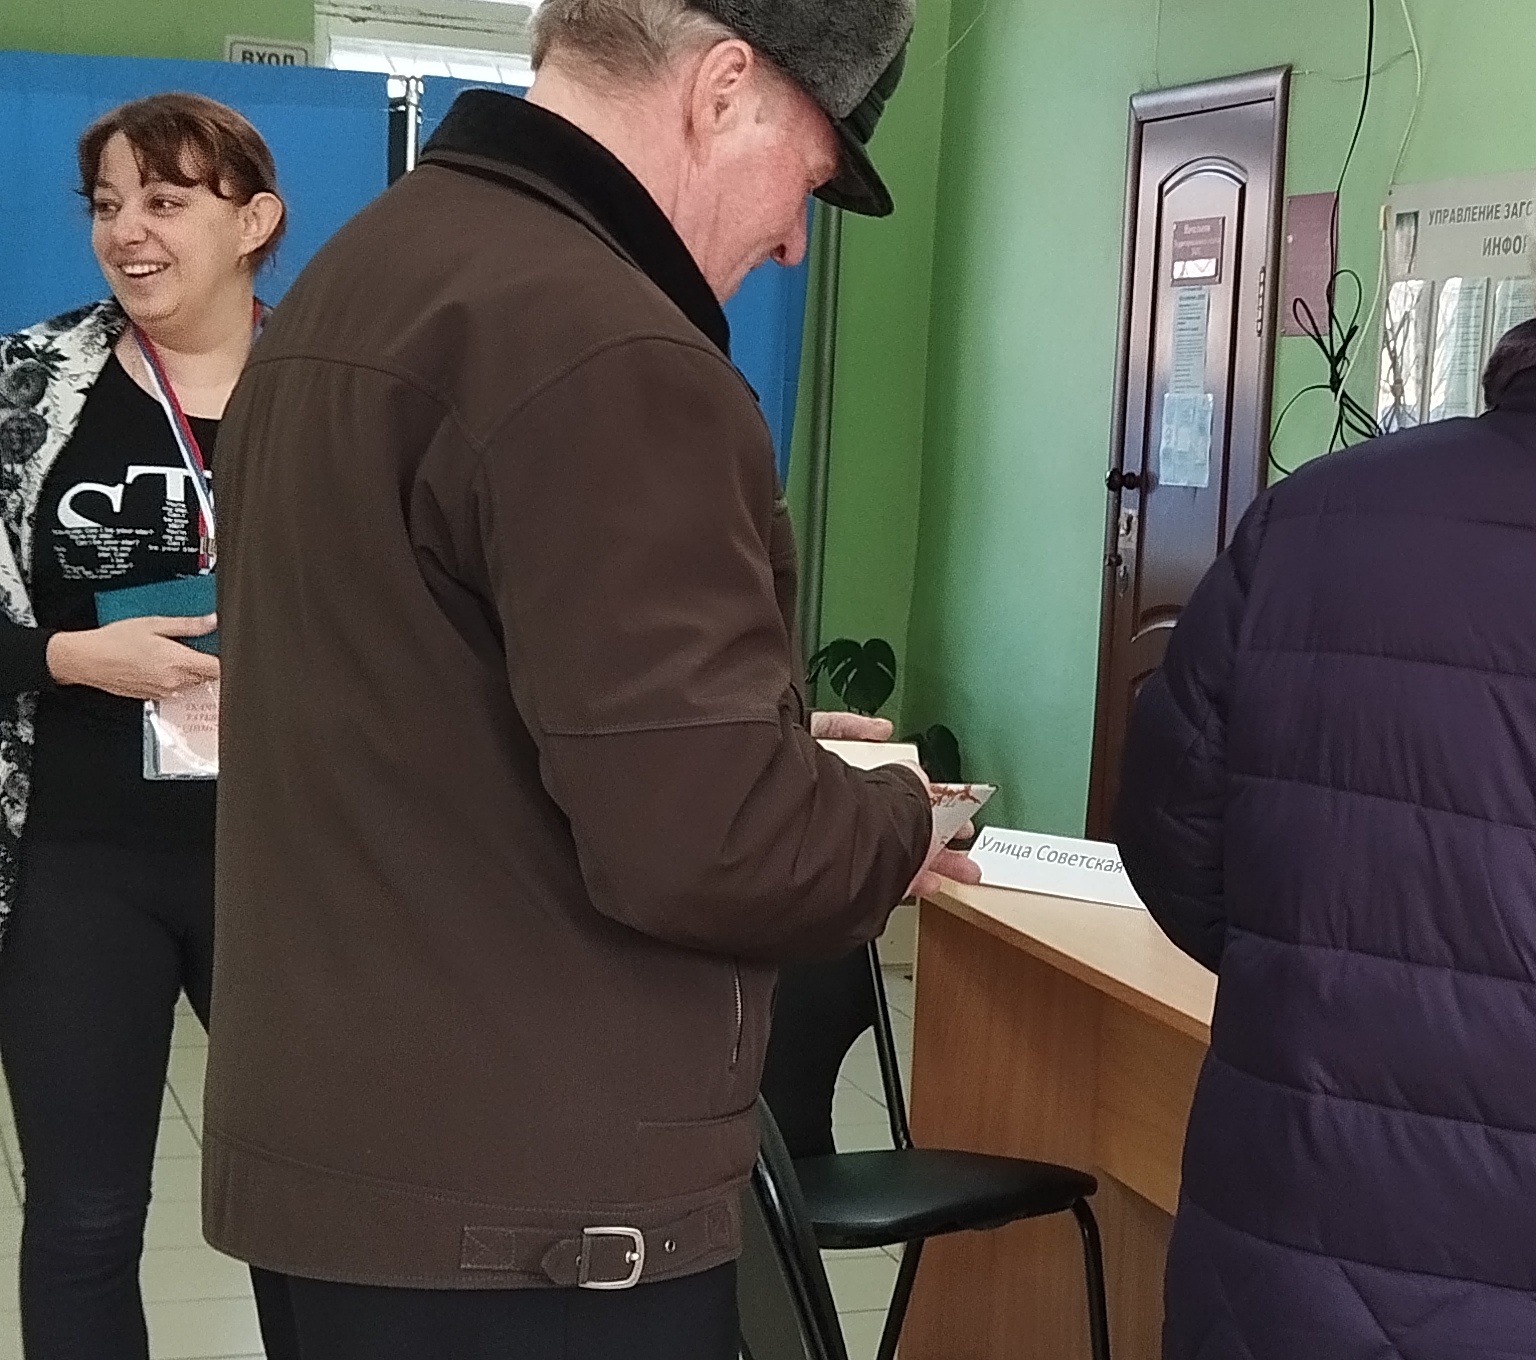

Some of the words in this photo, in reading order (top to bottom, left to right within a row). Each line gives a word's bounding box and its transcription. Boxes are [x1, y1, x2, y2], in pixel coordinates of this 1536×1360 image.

[1428, 204, 1501, 225] УПРАВЛЕНИЕ
[979, 835, 1032, 860] Улица
[1037, 845, 1123, 874] Советская
